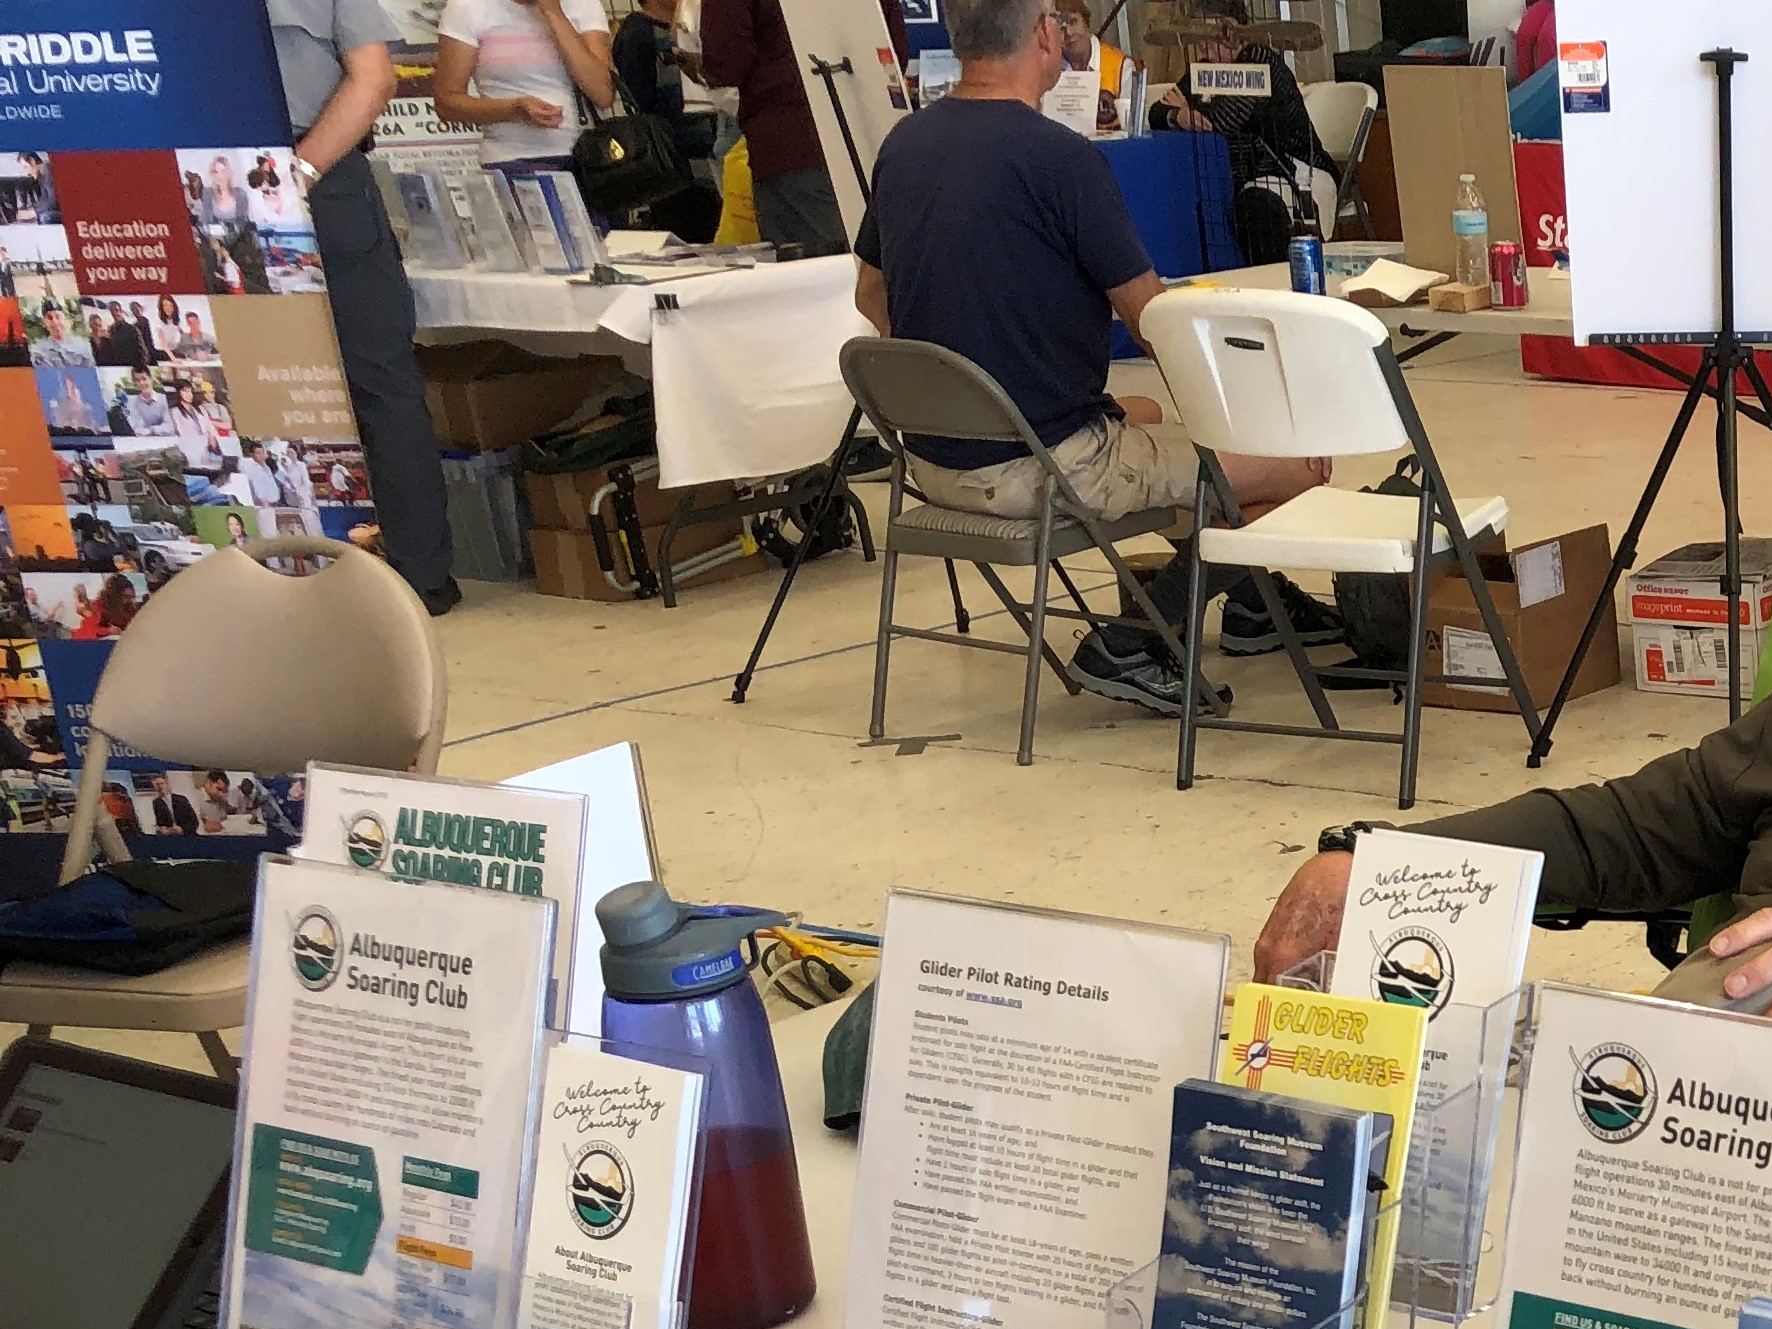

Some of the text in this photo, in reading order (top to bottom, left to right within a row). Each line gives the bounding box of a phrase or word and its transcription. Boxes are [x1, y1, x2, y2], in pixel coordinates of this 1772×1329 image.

[0, 29, 158, 65] RIDDLE
[26, 67, 162, 96] University
[1197, 70, 1214, 88] NEW
[1215, 70, 1243, 89] MEXICO
[76, 220, 169, 239] Education
[82, 242, 166, 260] delivered
[85, 266, 168, 284] your way
[1636, 583, 1663, 595] Office
[393, 806, 548, 864] ALBUQUERQUE
[487, 861, 544, 897] CLUB
[1374, 858, 1482, 887] Welcome to
[1359, 881, 1498, 907] Cross Country
[1388, 900, 1469, 924] Country
[350, 932, 474, 976] Albuquerque
[346, 965, 469, 1010] Soaring Club
[920, 959, 1110, 1003] Glider Pilot Rating Details
[1273, 1000, 1370, 1045] GLIDER
[1290, 1044, 1400, 1088] FLIGHTS
[565, 1075, 653, 1101] Welcome to
[553, 1097, 666, 1121] Cross Country
[577, 1113, 642, 1139] Country
[1659, 1118, 1772, 1170] Soaring
[1575, 1163, 1600, 1179] flight
[1603, 1170, 1656, 1188] operations
[1658, 1179, 1670, 1191] 30
[1672, 1184, 1712, 1200] minutes
[1715, 1192, 1735, 1204] east
[1738, 1196, 1749, 1207] of
[1577, 1148, 1640, 1170] Albuquerque
[1642, 1160, 1681, 1180] Soaring
[1682, 1168, 1706, 1183] Club
[1708, 1176, 1716, 1185] is
[1719, 1179, 1725, 1187] a
[1727, 1179, 1744, 1190] not
[1746, 1181, 1760, 1193] for
[1555, 1311, 1579, 1328] FIND
[1580, 1317, 1594, 1329] US
